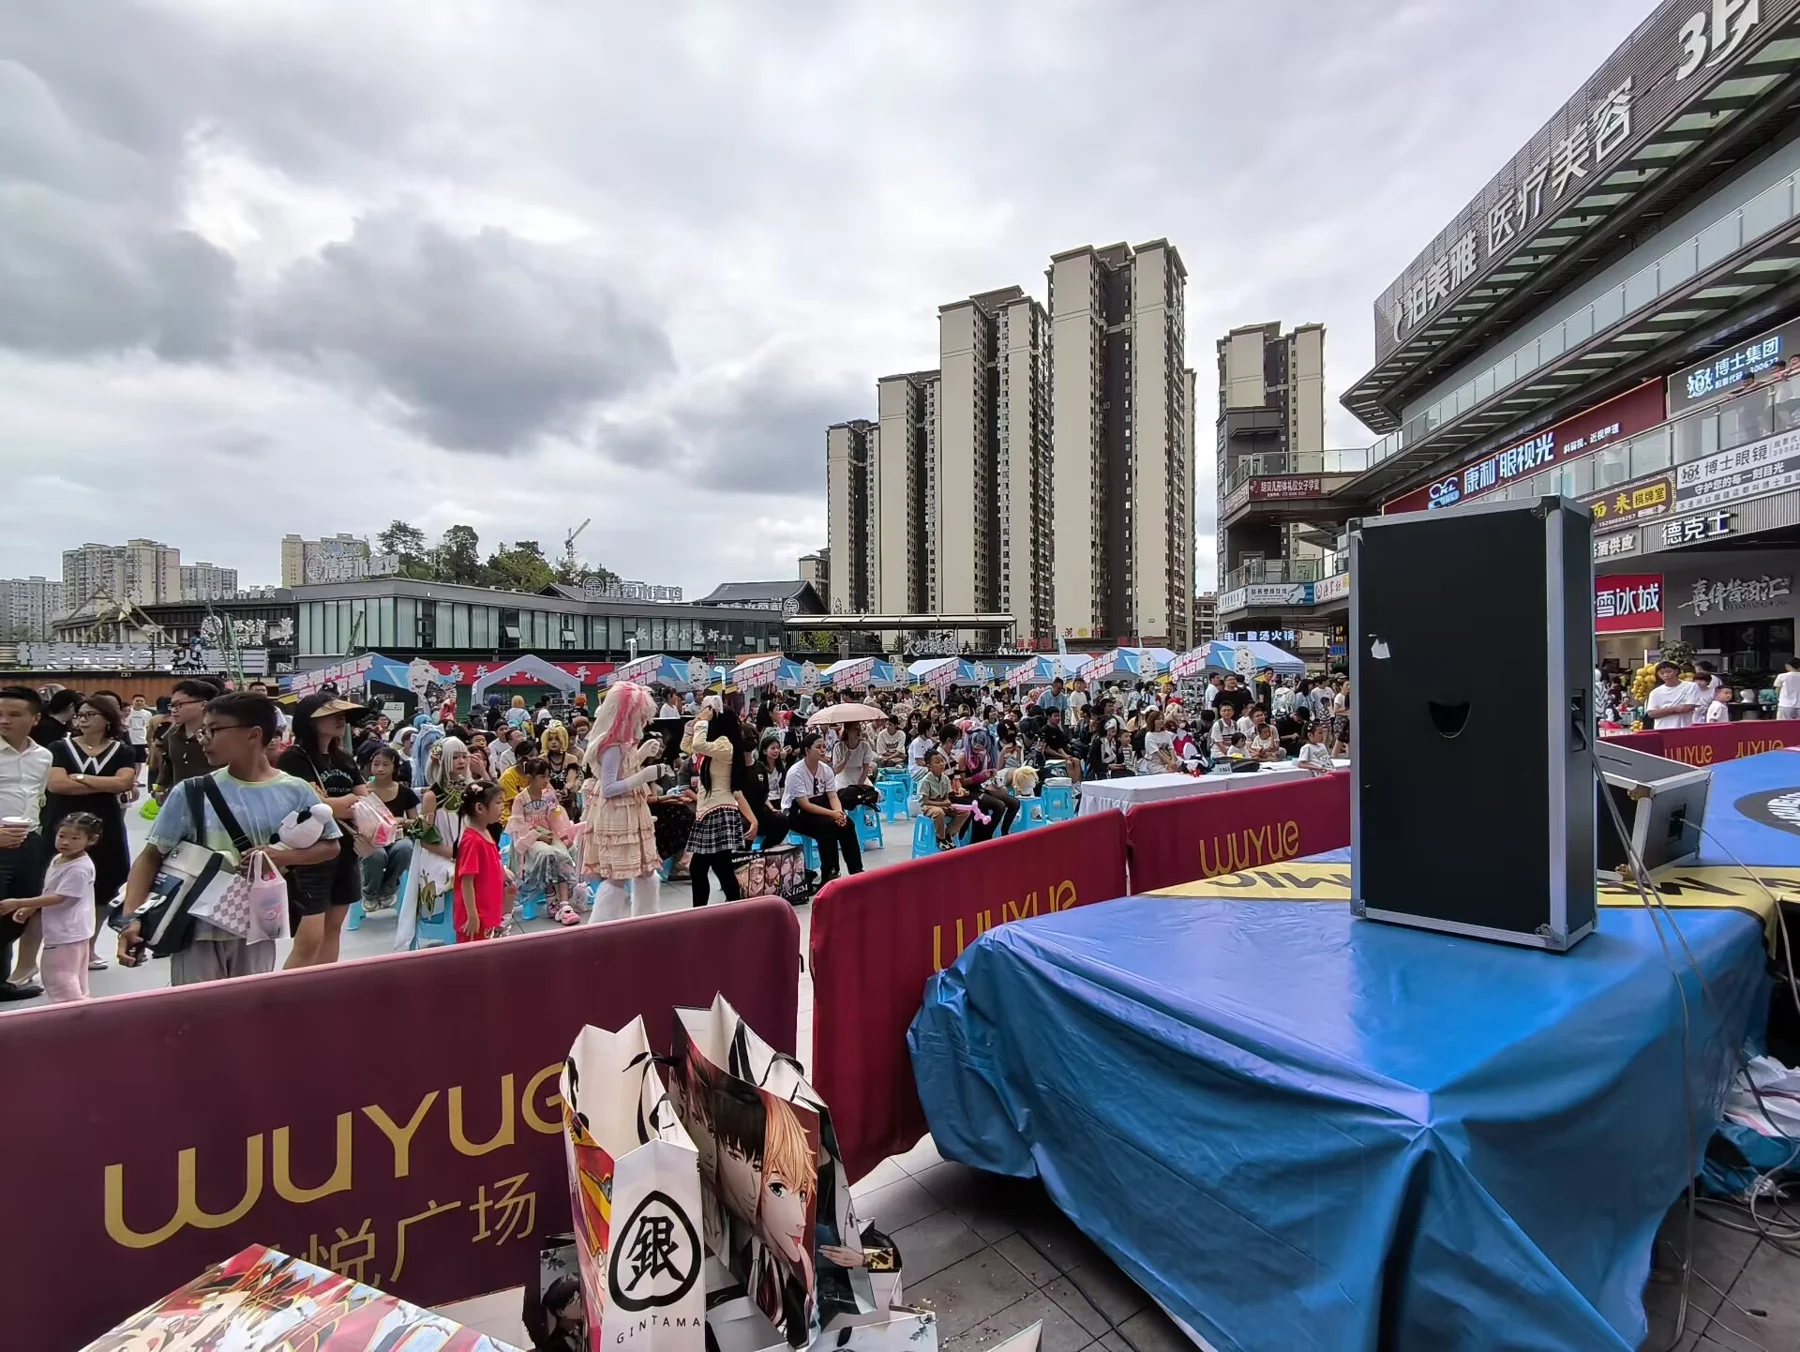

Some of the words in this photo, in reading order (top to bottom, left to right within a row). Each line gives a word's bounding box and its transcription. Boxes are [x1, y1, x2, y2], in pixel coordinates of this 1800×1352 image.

[1488, 76, 1633, 257] 医疗美容
[1715, 336, 1779, 378] 博士集团
[1705, 444, 1767, 476] 博士眼镜
[1635, 487, 1665, 505] 棋牌室
[1662, 511, 1731, 545] 德克士
[1595, 583, 1659, 618] 雪冰城
[205, 1172, 536, 1287] 悦广场
[626, 1215, 685, 1292] 銀
[616, 1314, 701, 1345] GINTAMA
